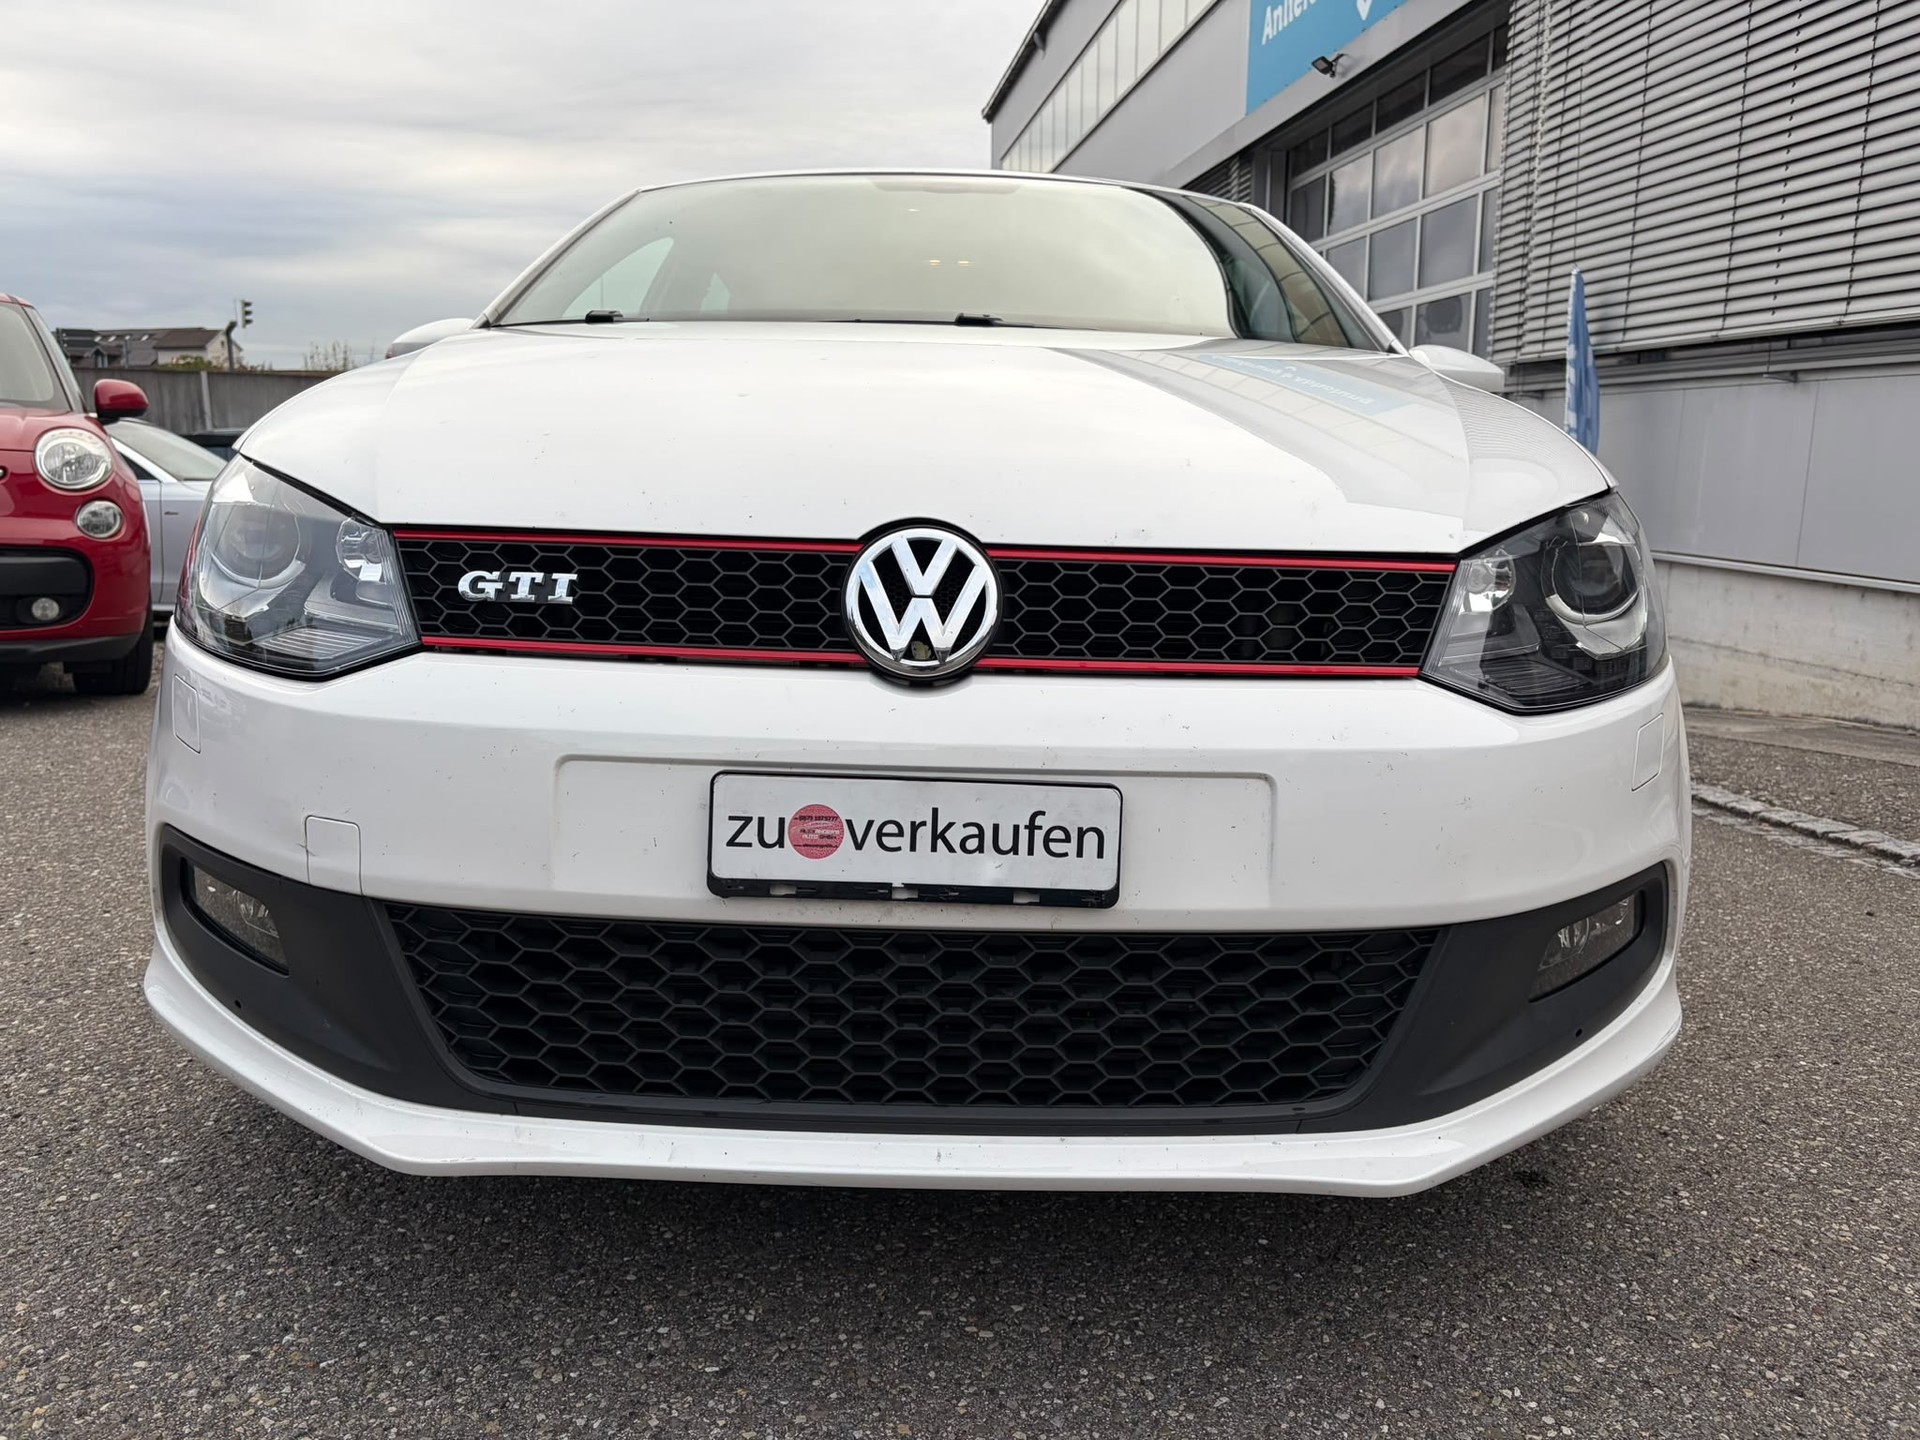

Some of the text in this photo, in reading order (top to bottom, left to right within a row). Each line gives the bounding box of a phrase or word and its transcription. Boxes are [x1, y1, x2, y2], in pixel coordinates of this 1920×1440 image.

[457, 570, 578, 605] GTI
[851, 532, 992, 671] VW
[726, 806, 1105, 860] zu verkaufen
